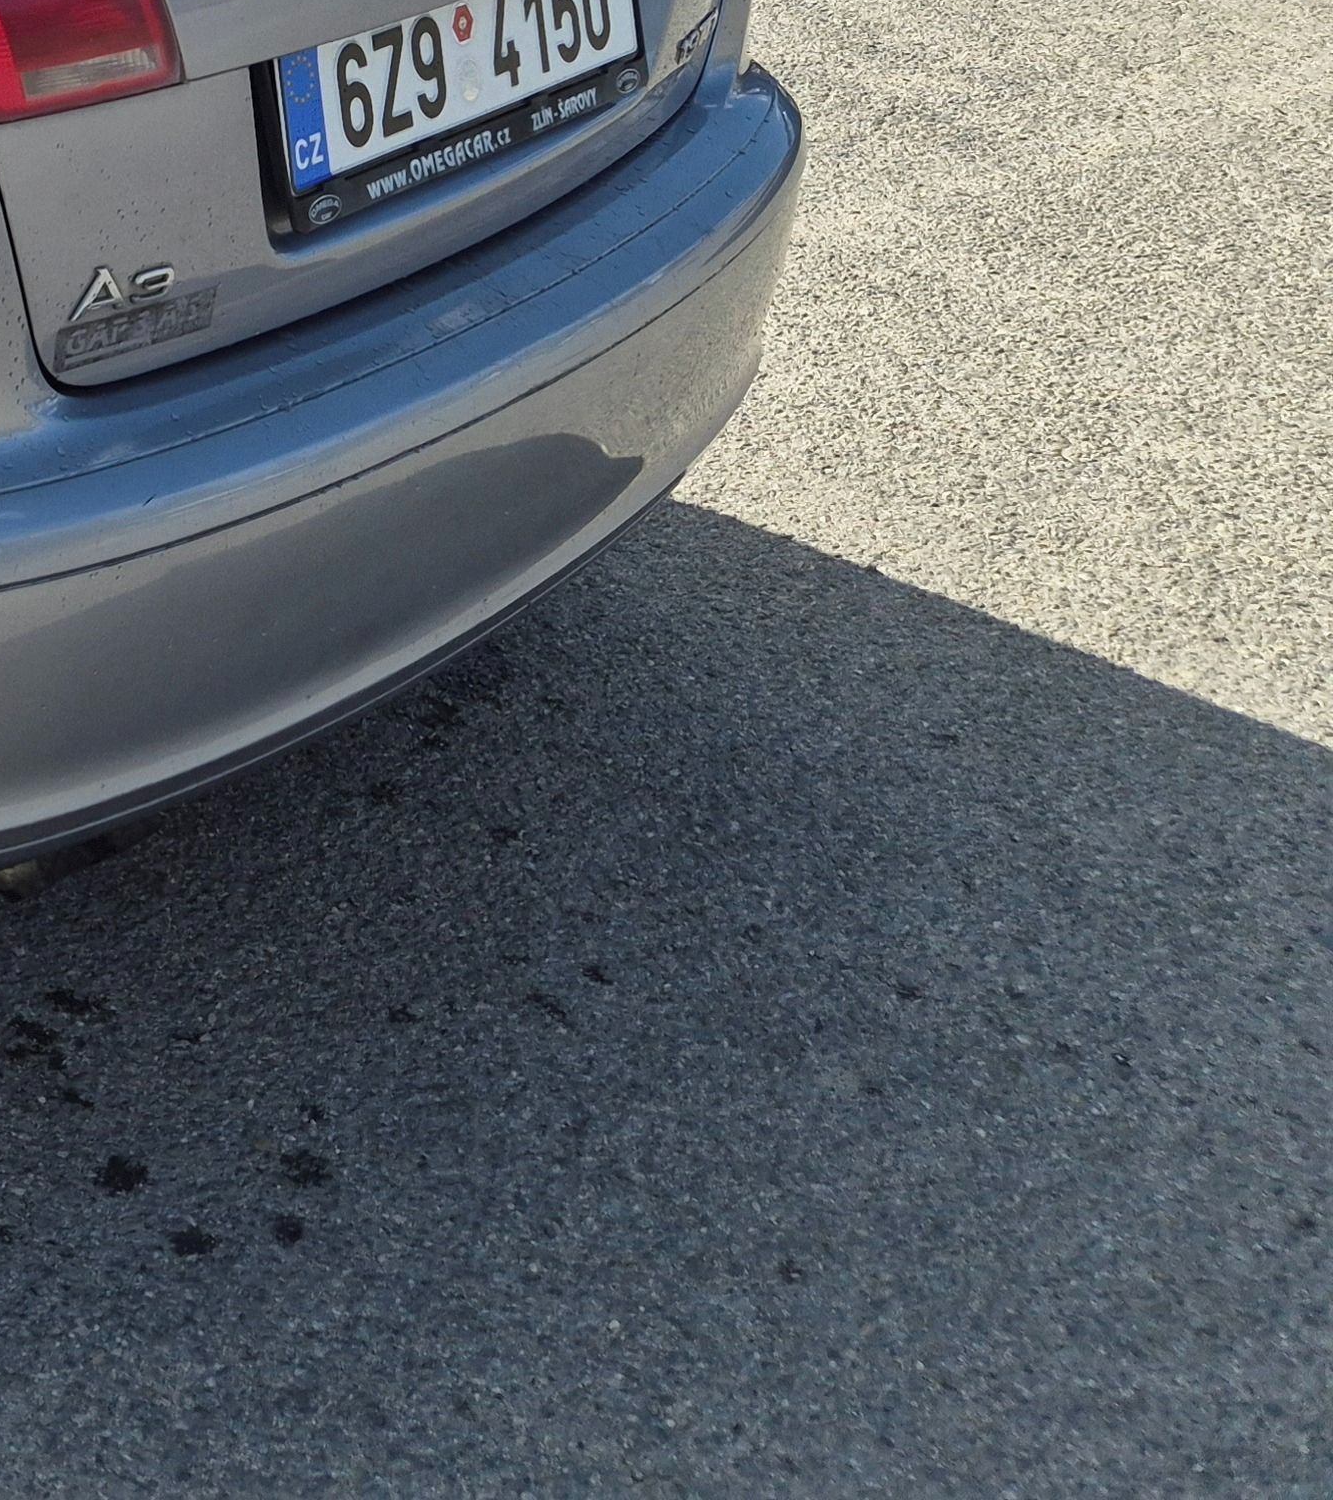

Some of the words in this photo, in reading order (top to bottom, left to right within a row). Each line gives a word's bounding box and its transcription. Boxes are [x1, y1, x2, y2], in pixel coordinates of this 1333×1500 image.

[335, 15, 448, 149] 6Z9
[294, 132, 325, 171] CZ
[365, 126, 512, 201] www.OMEGACAR.cz
[68, 264, 176, 322] A3
